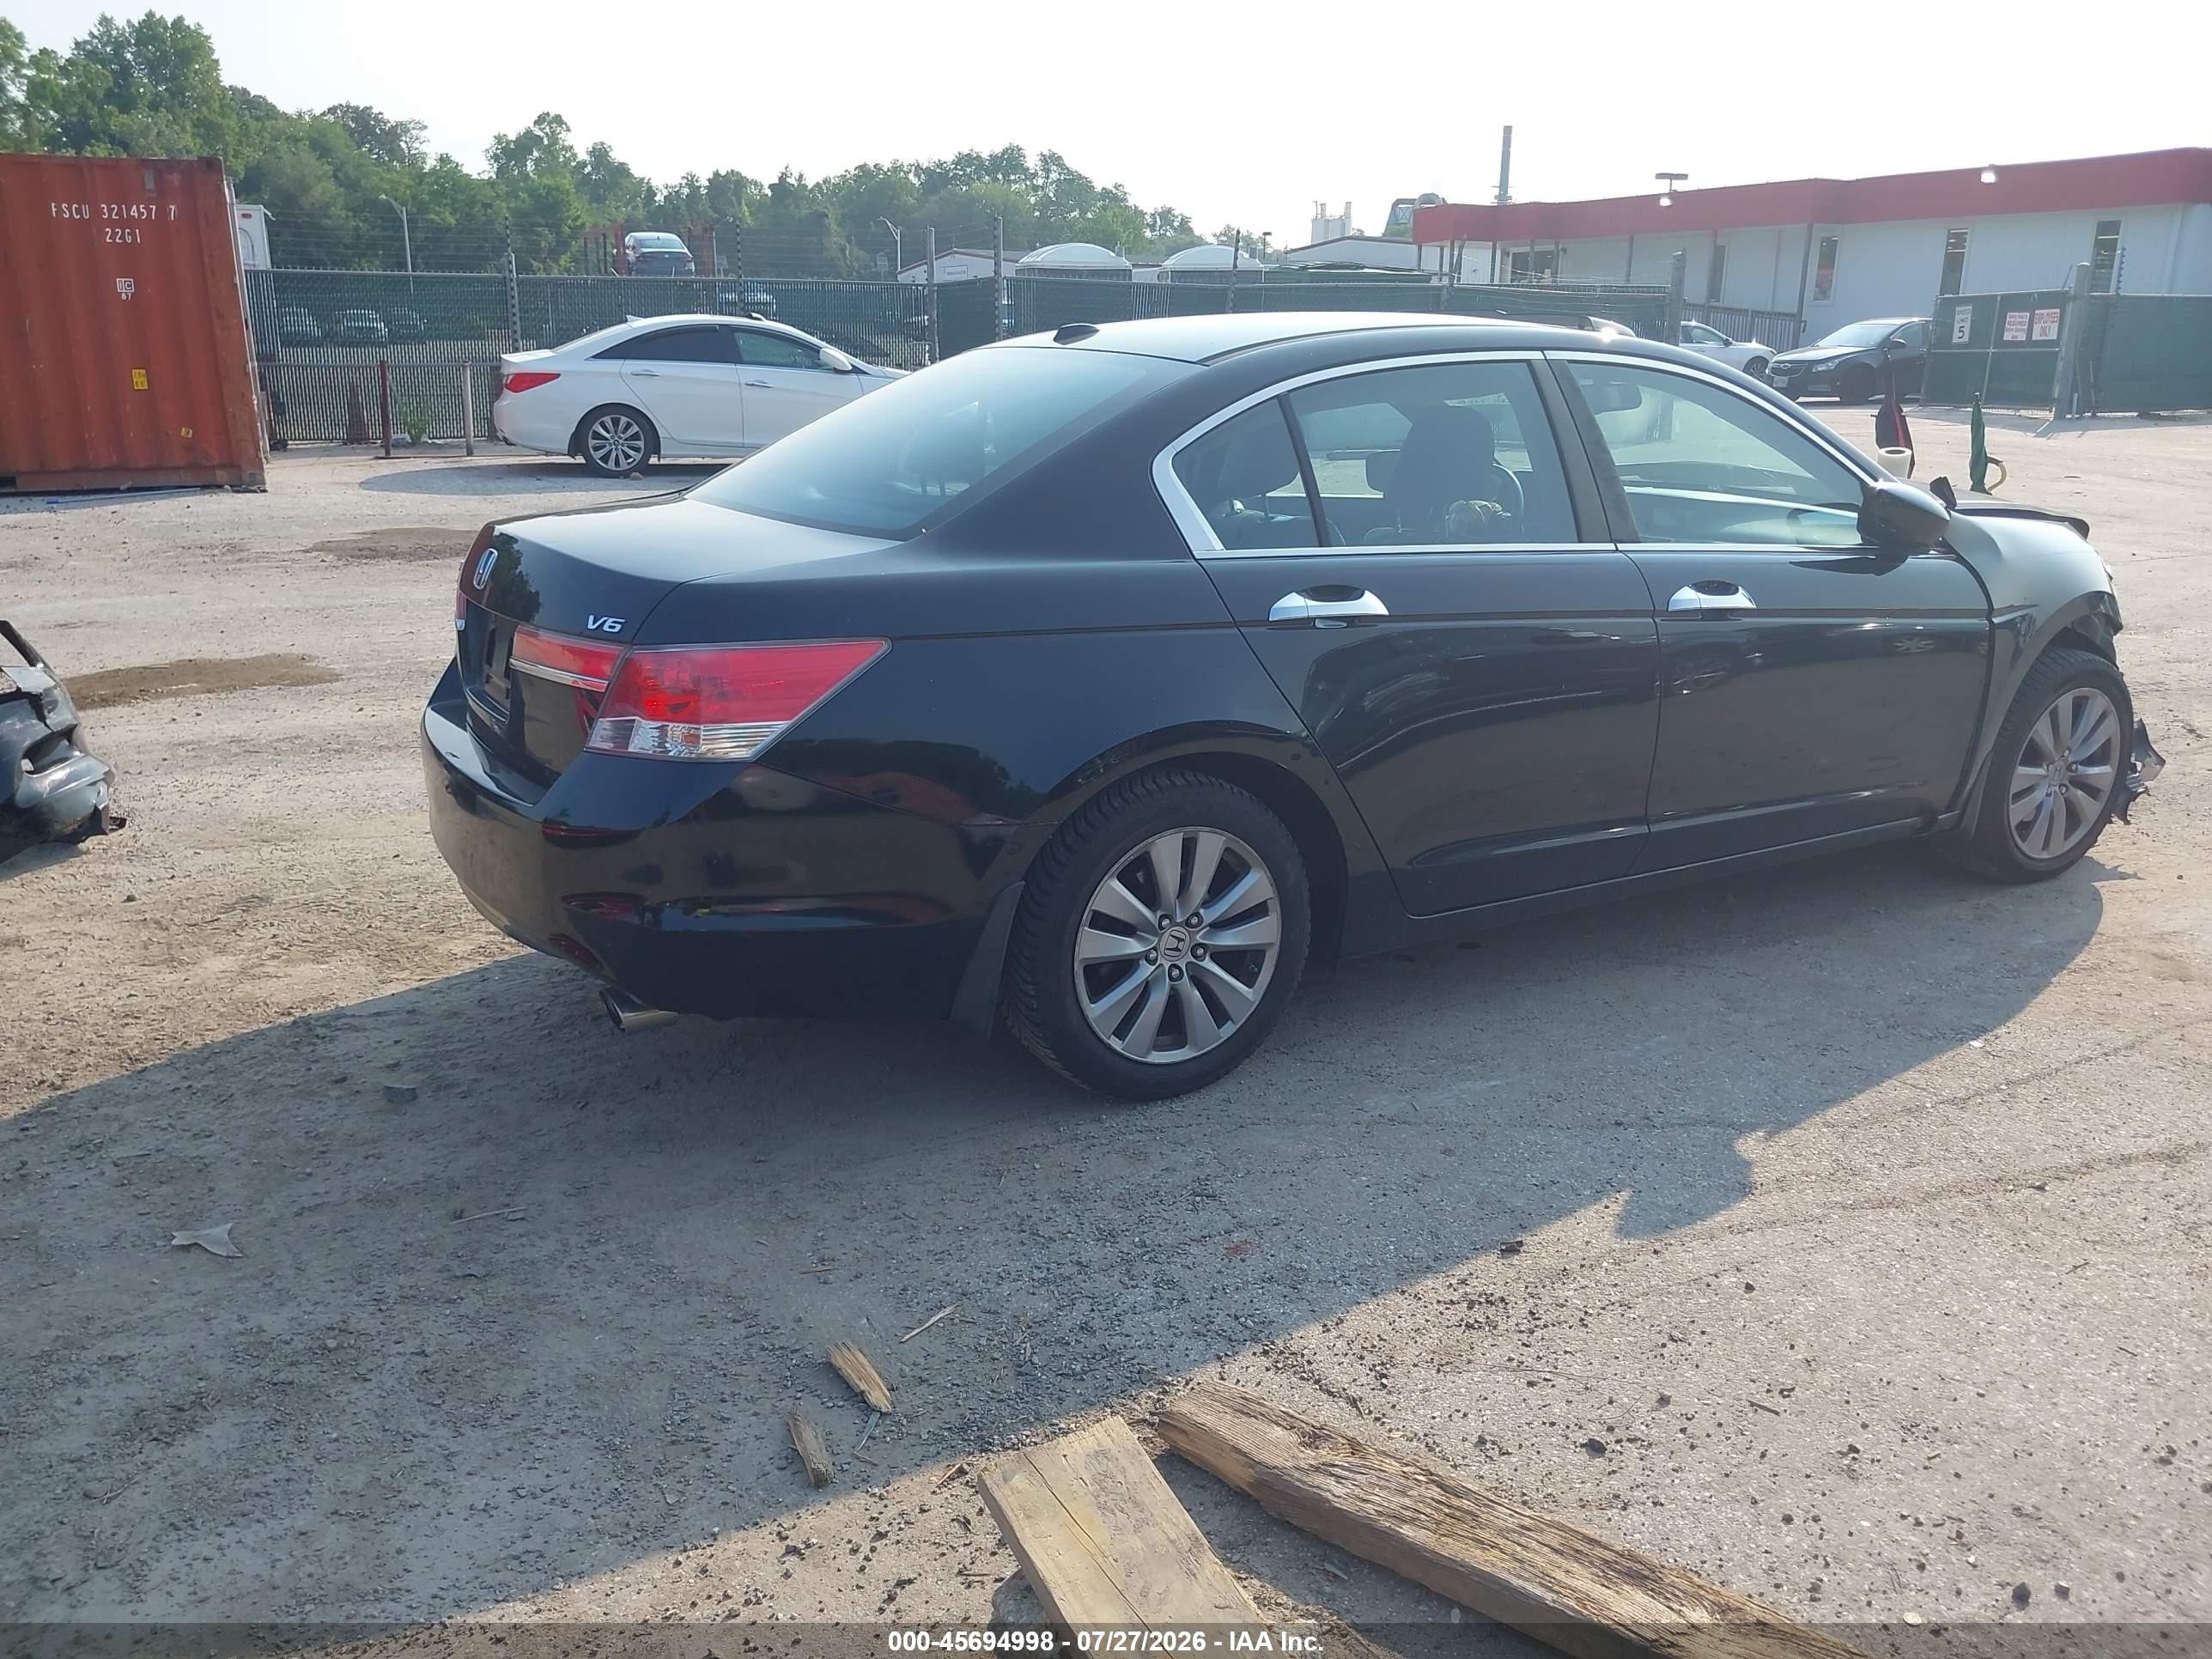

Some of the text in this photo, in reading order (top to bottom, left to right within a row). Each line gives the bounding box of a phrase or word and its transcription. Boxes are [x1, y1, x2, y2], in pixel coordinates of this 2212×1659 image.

[51, 203, 90, 220] FSCU
[100, 204, 157, 221] 321457
[105, 228, 141, 244] 22G1
[1957, 325, 1966, 339] 5
[587, 615, 626, 633] V6
